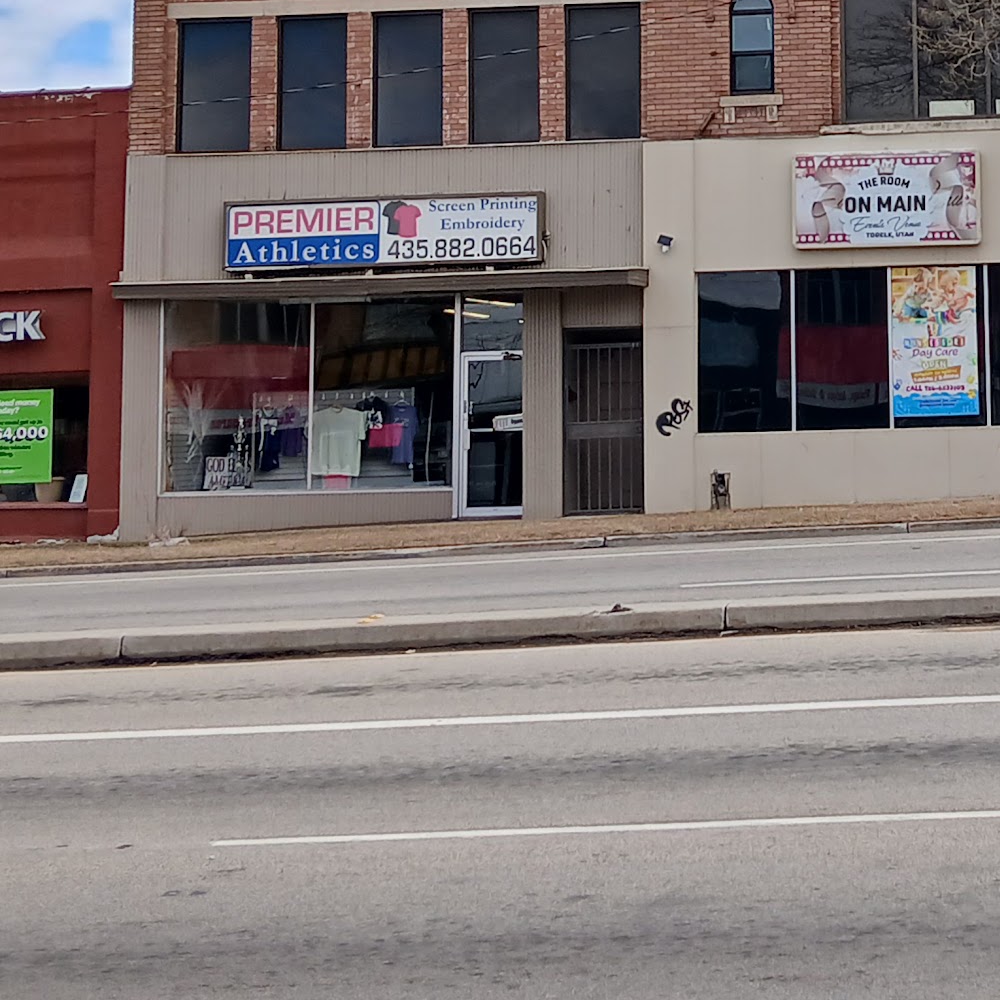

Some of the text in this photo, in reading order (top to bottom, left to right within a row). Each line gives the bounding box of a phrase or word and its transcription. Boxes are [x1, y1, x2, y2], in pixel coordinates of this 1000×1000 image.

[857, 176, 911, 190] THE ROOM
[428, 197, 537, 213] Screen Printing
[844, 195, 926, 213] ON MAIN
[233, 206, 374, 235] PREMIER
[440, 217, 525, 231] Embroidery
[233, 238, 375, 264] Athletics
[387, 235, 536, 259] 435.882.0664
[912, 348, 959, 359] Day Care
